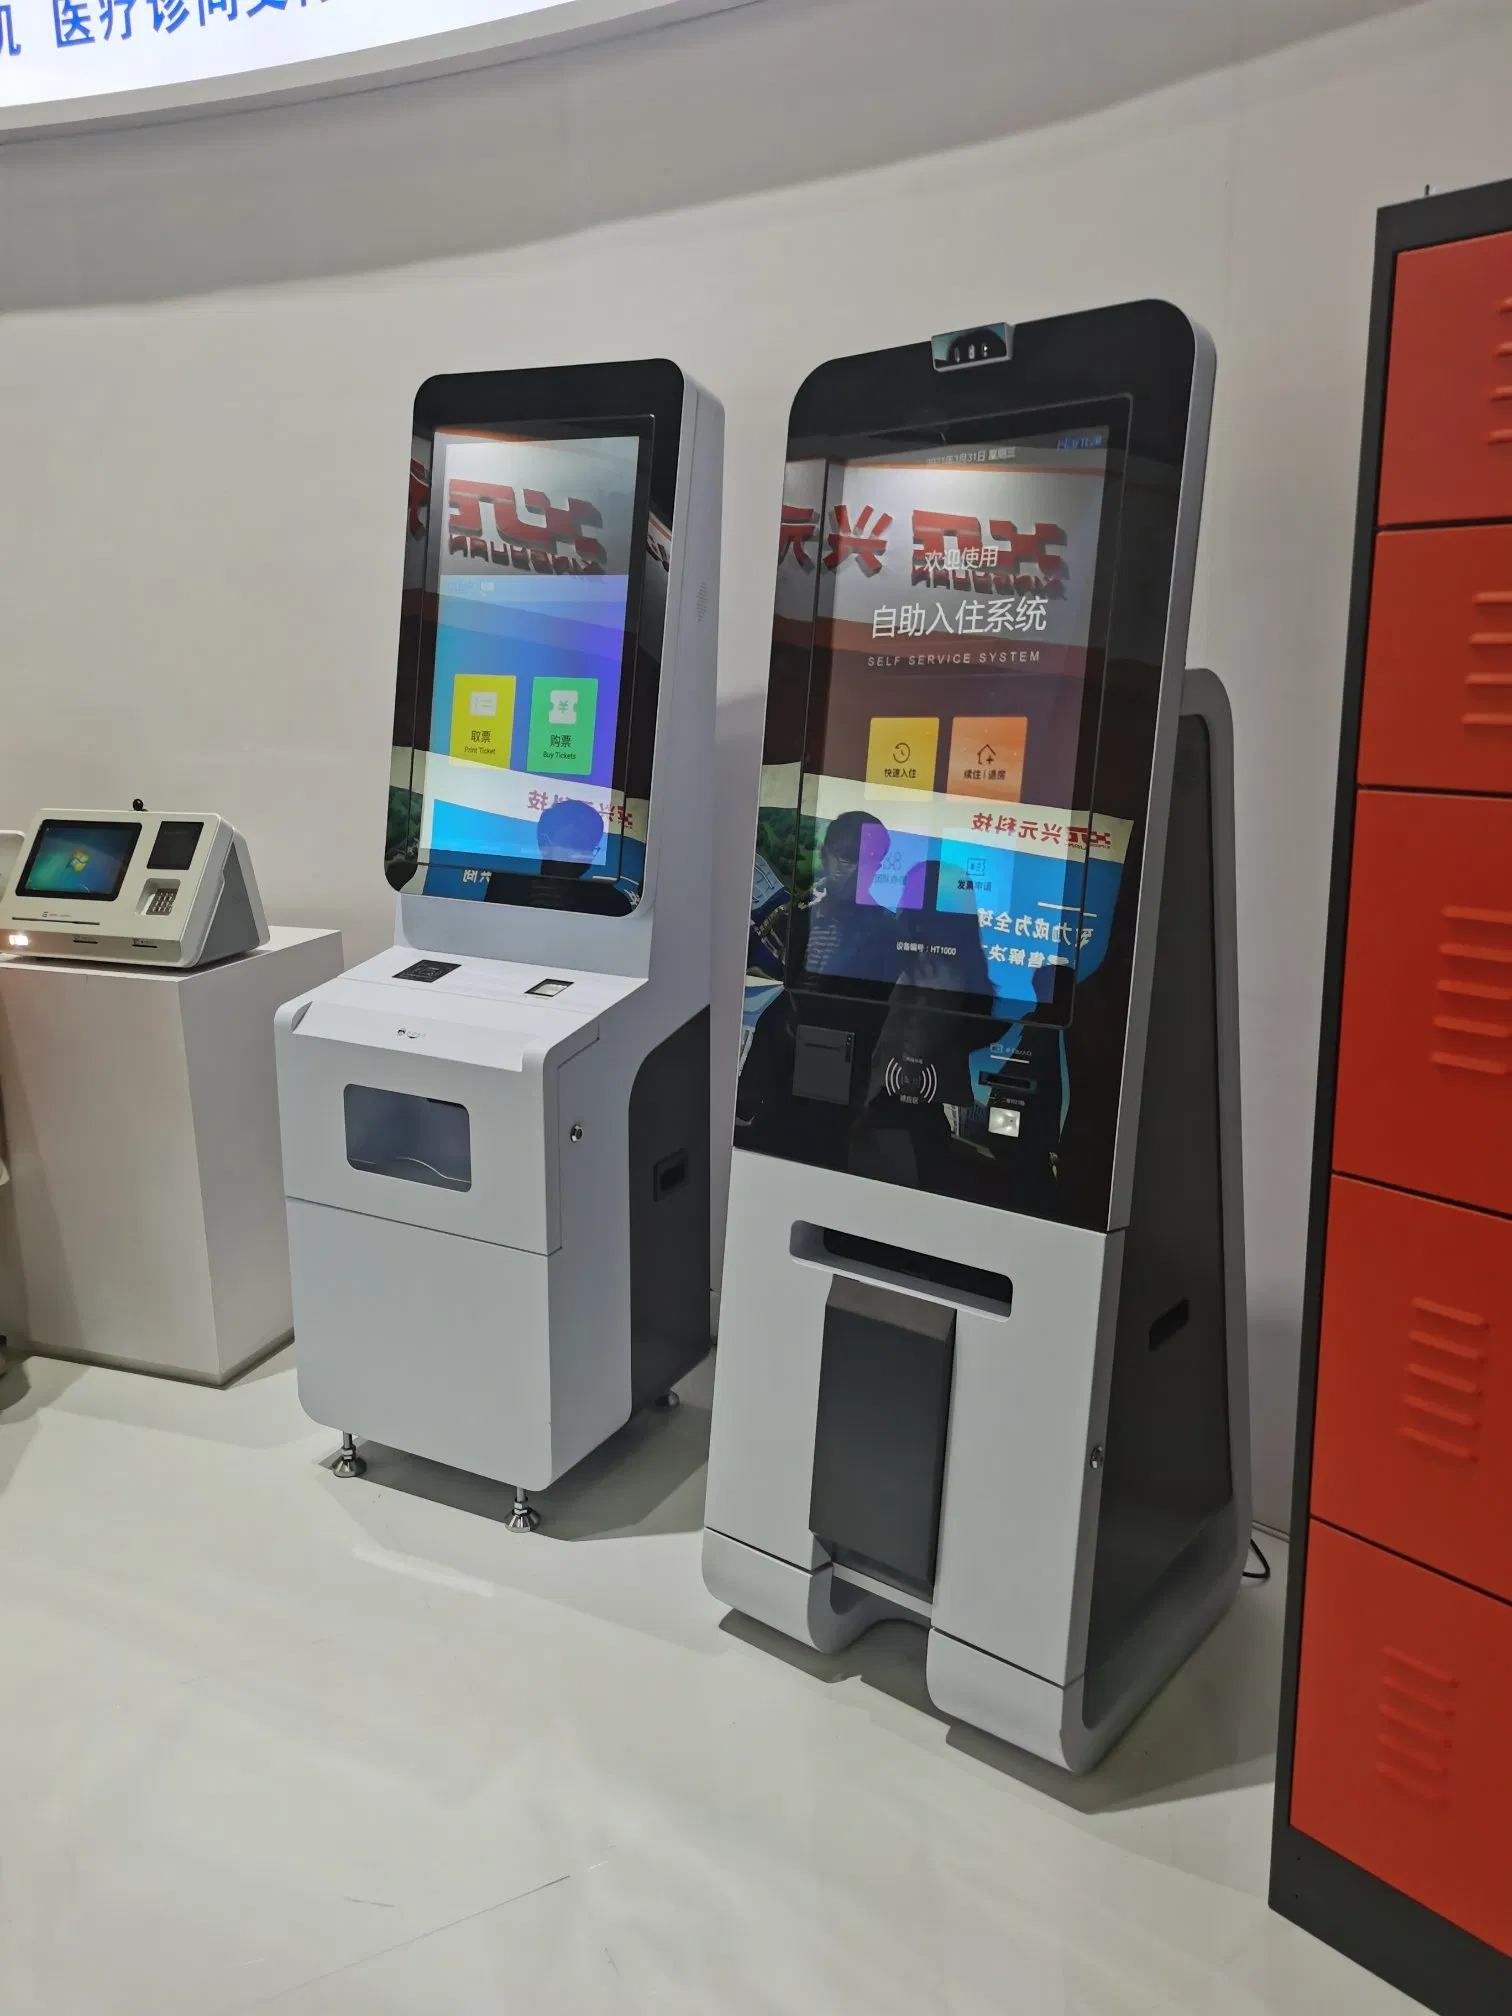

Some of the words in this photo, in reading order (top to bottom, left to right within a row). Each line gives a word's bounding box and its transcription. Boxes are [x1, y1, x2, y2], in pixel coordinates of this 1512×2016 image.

[921, 545, 999, 572] 欢迎使用
[872, 595, 1049, 639] 自助入住系统
[867, 656, 901, 667] SELF
[908, 653, 971, 666] SERVICE
[979, 651, 1040, 664] SYSTEM
[471, 730, 491, 743] 取票
[550, 734, 572, 748] 购票
[464, 746, 478, 755] Print
[480, 747, 496, 755] Ticket
[543, 751, 553, 760] Buy
[556, 751, 576, 760] Tickets
[884, 768, 917, 779] 快速入住
[957, 880, 992, 892] 发票申请
